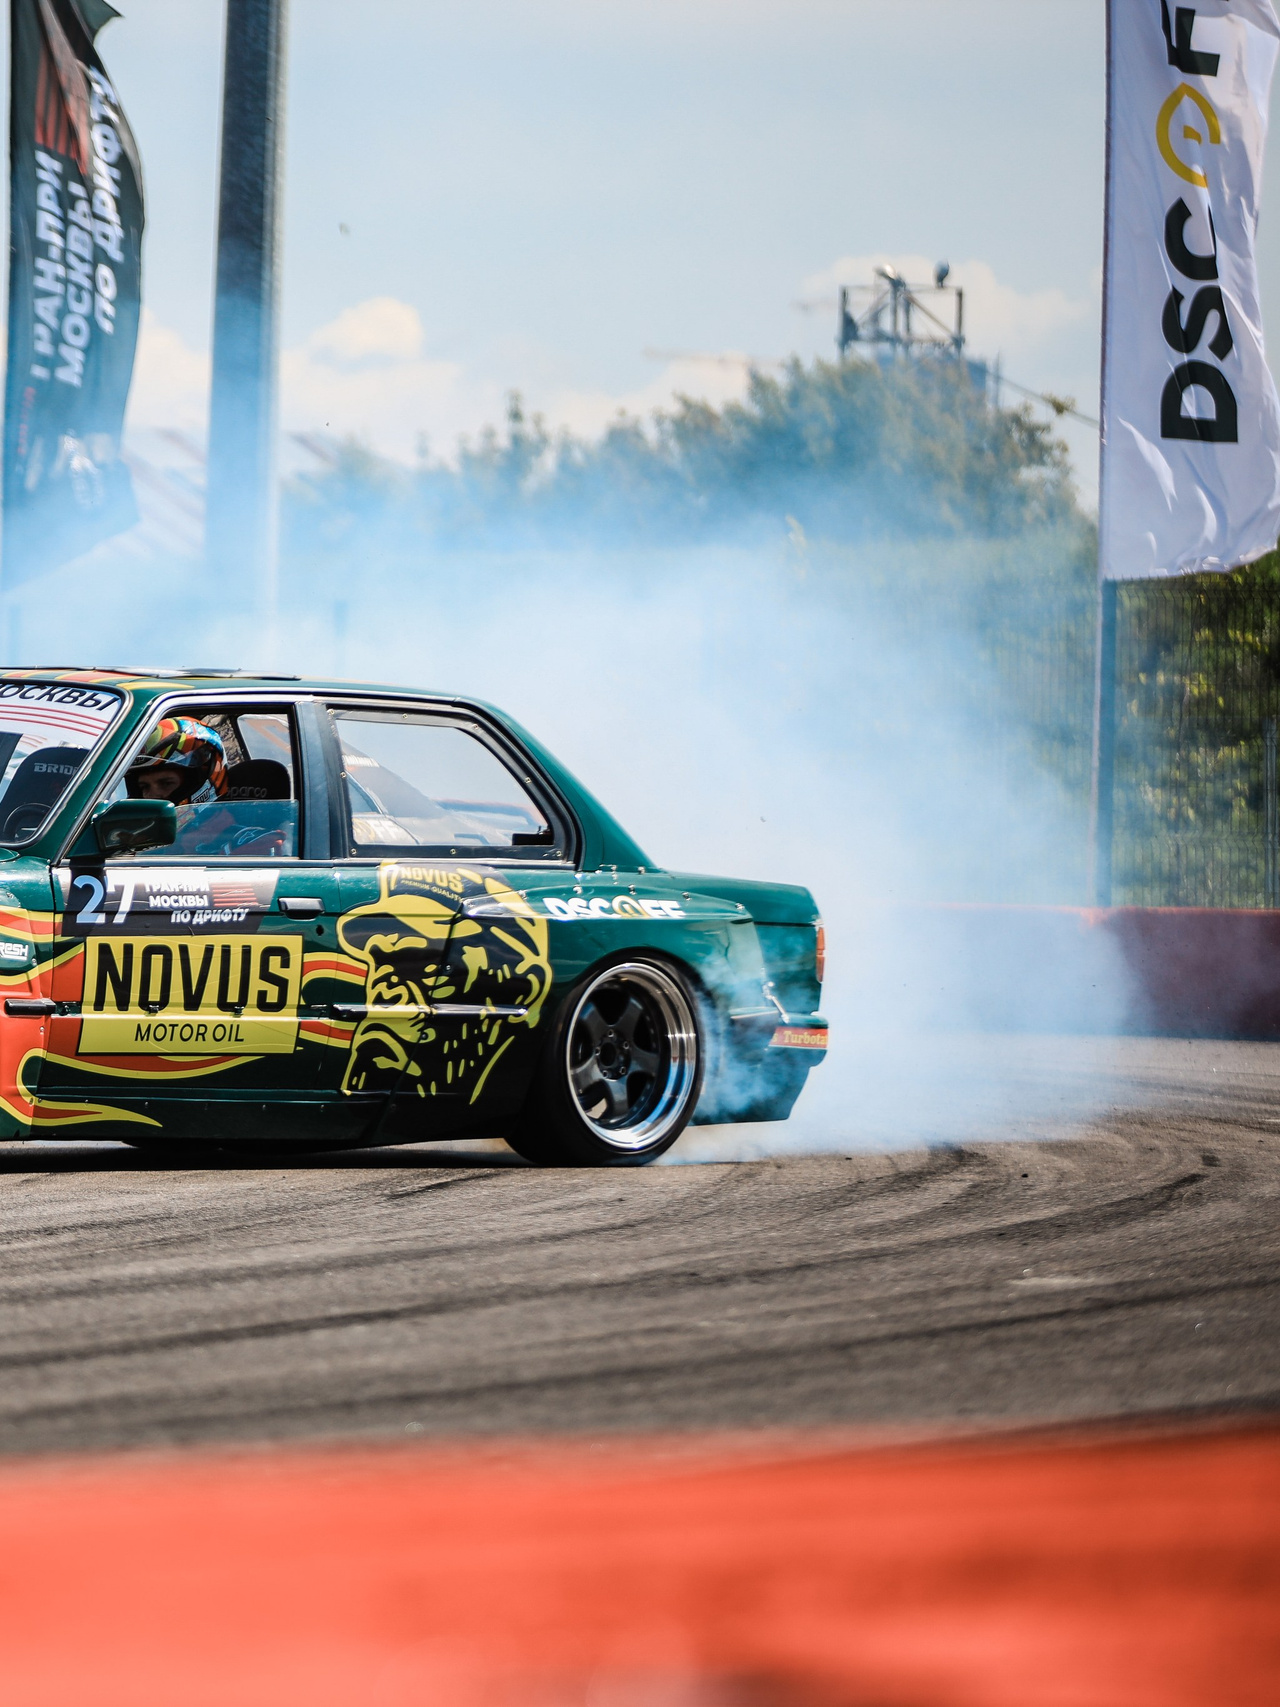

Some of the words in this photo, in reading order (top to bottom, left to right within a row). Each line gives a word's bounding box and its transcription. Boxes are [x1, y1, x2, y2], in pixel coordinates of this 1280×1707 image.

[1156, 0, 1239, 443] DSCOF
[55, 180, 93, 388] МОСКВЫ
[93, 262, 117, 335] ПО
[73, 874, 136, 924] 27
[148, 895, 209, 908] МОСКВЫ
[401, 867, 464, 893] NOVUS
[170, 908, 191, 924] ПО
[192, 907, 250, 925] ДРИФТУ
[93, 942, 291, 1013] NOVUS
[134, 1023, 207, 1042] MOTOR
[213, 1023, 245, 1042] OIL
